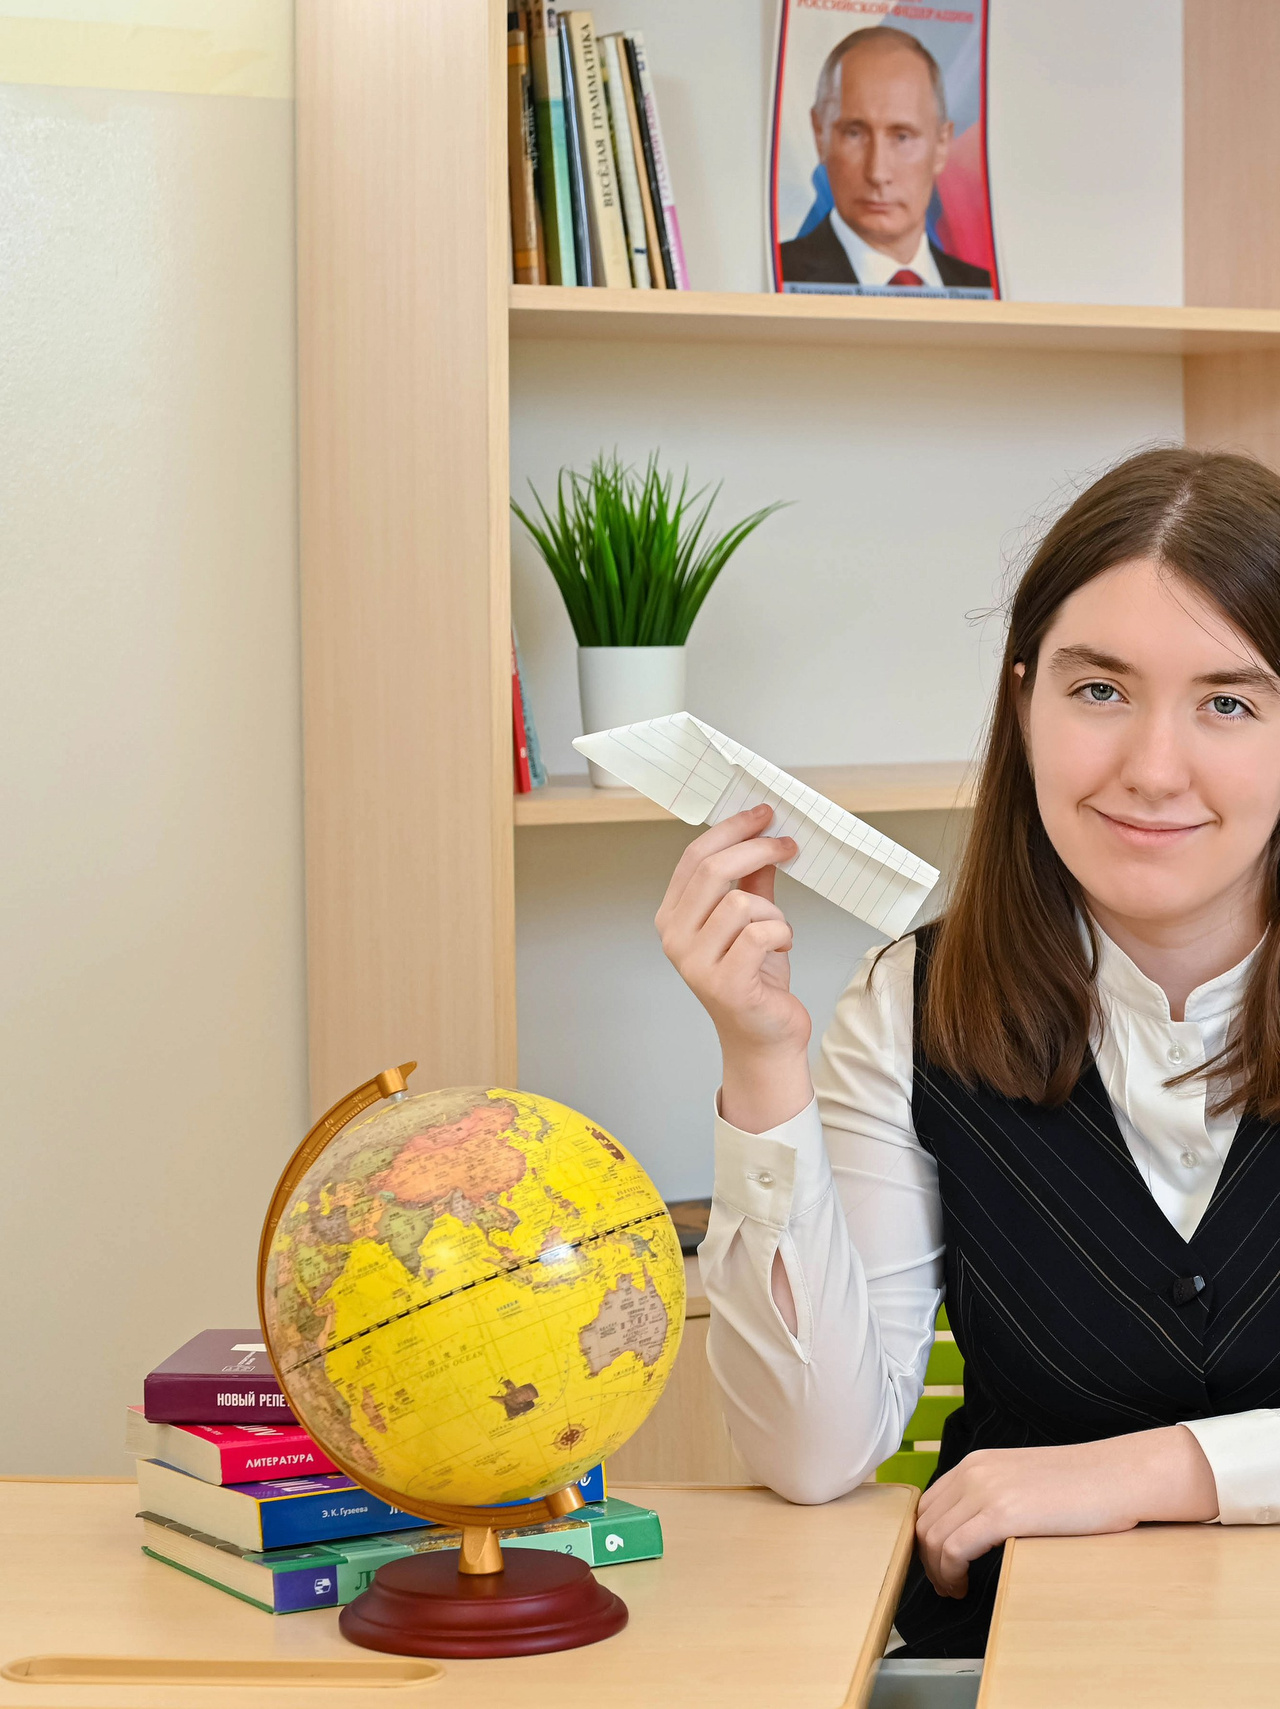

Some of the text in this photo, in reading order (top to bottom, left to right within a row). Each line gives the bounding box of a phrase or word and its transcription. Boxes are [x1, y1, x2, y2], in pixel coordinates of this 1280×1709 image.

[580, 24, 614, 207] ВЕСЁЛАЯ ГРАММАТИКА
[420, 1350, 483, 1382] INDIAN OCEAN
[217, 1391, 290, 1407] НОВЫЙ РЕПЕ
[246, 1453, 314, 1469] ЛИТЕРАТУРА
[322, 1506, 368, 1518] Э. К. Гузеева
